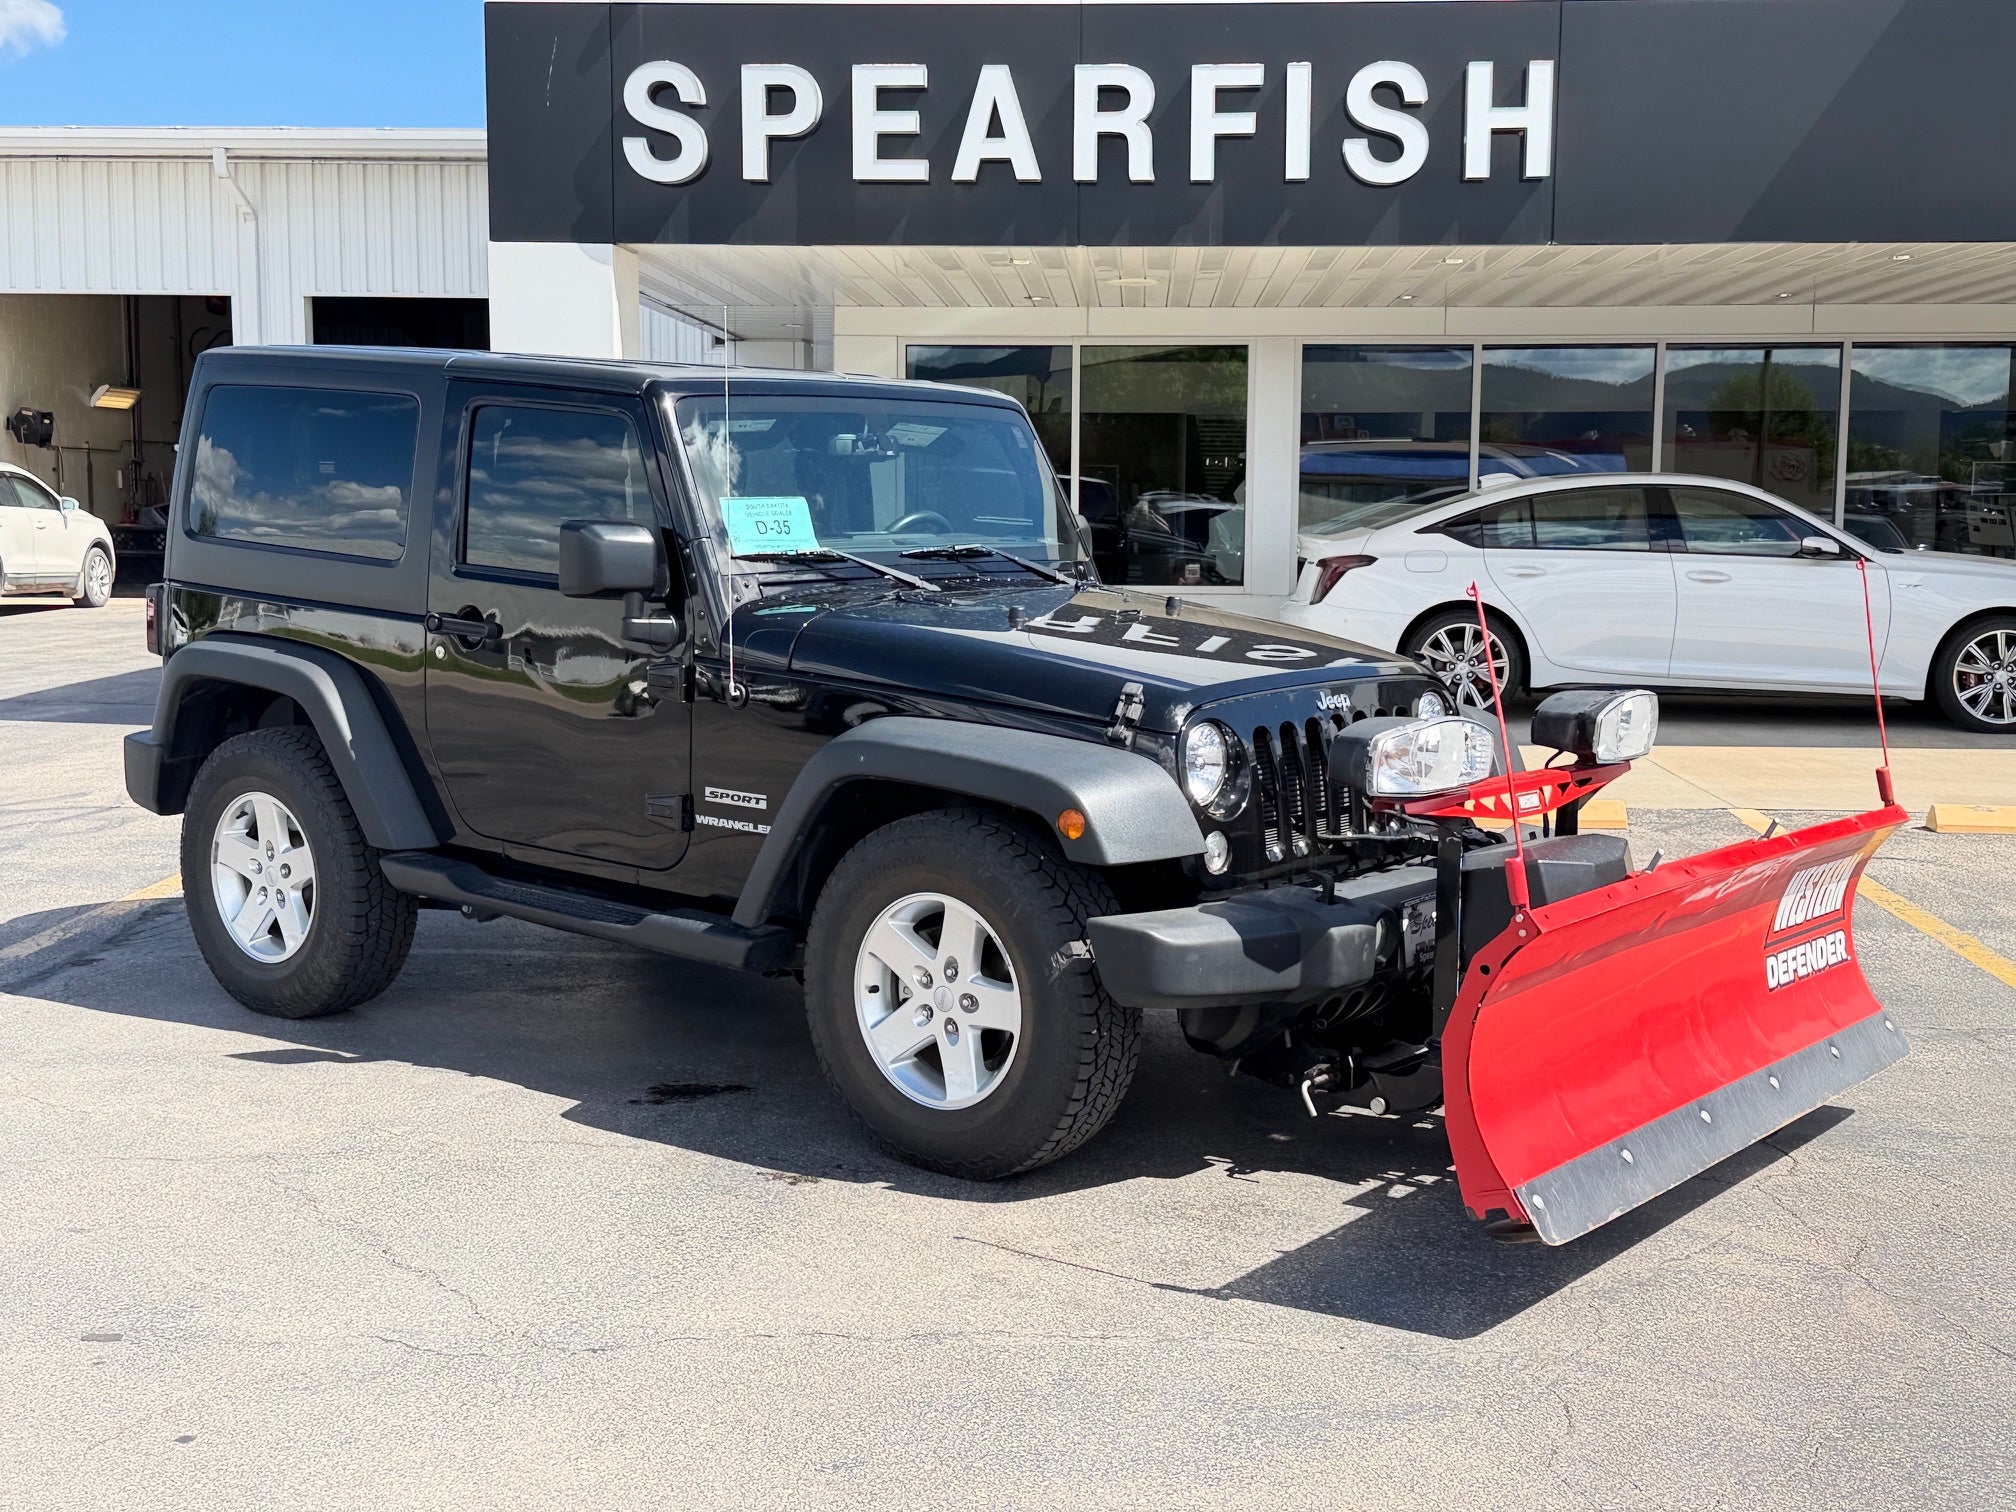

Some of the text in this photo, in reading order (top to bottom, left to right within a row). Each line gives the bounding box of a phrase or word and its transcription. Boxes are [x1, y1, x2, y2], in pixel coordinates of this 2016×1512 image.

[621, 59, 1556, 186] SPEARFISH
[755, 520, 791, 535] D-35
[1315, 691, 1351, 712] Jeep
[709, 790, 764, 805] SPORT
[1766, 930, 1848, 990] DEFENDER
